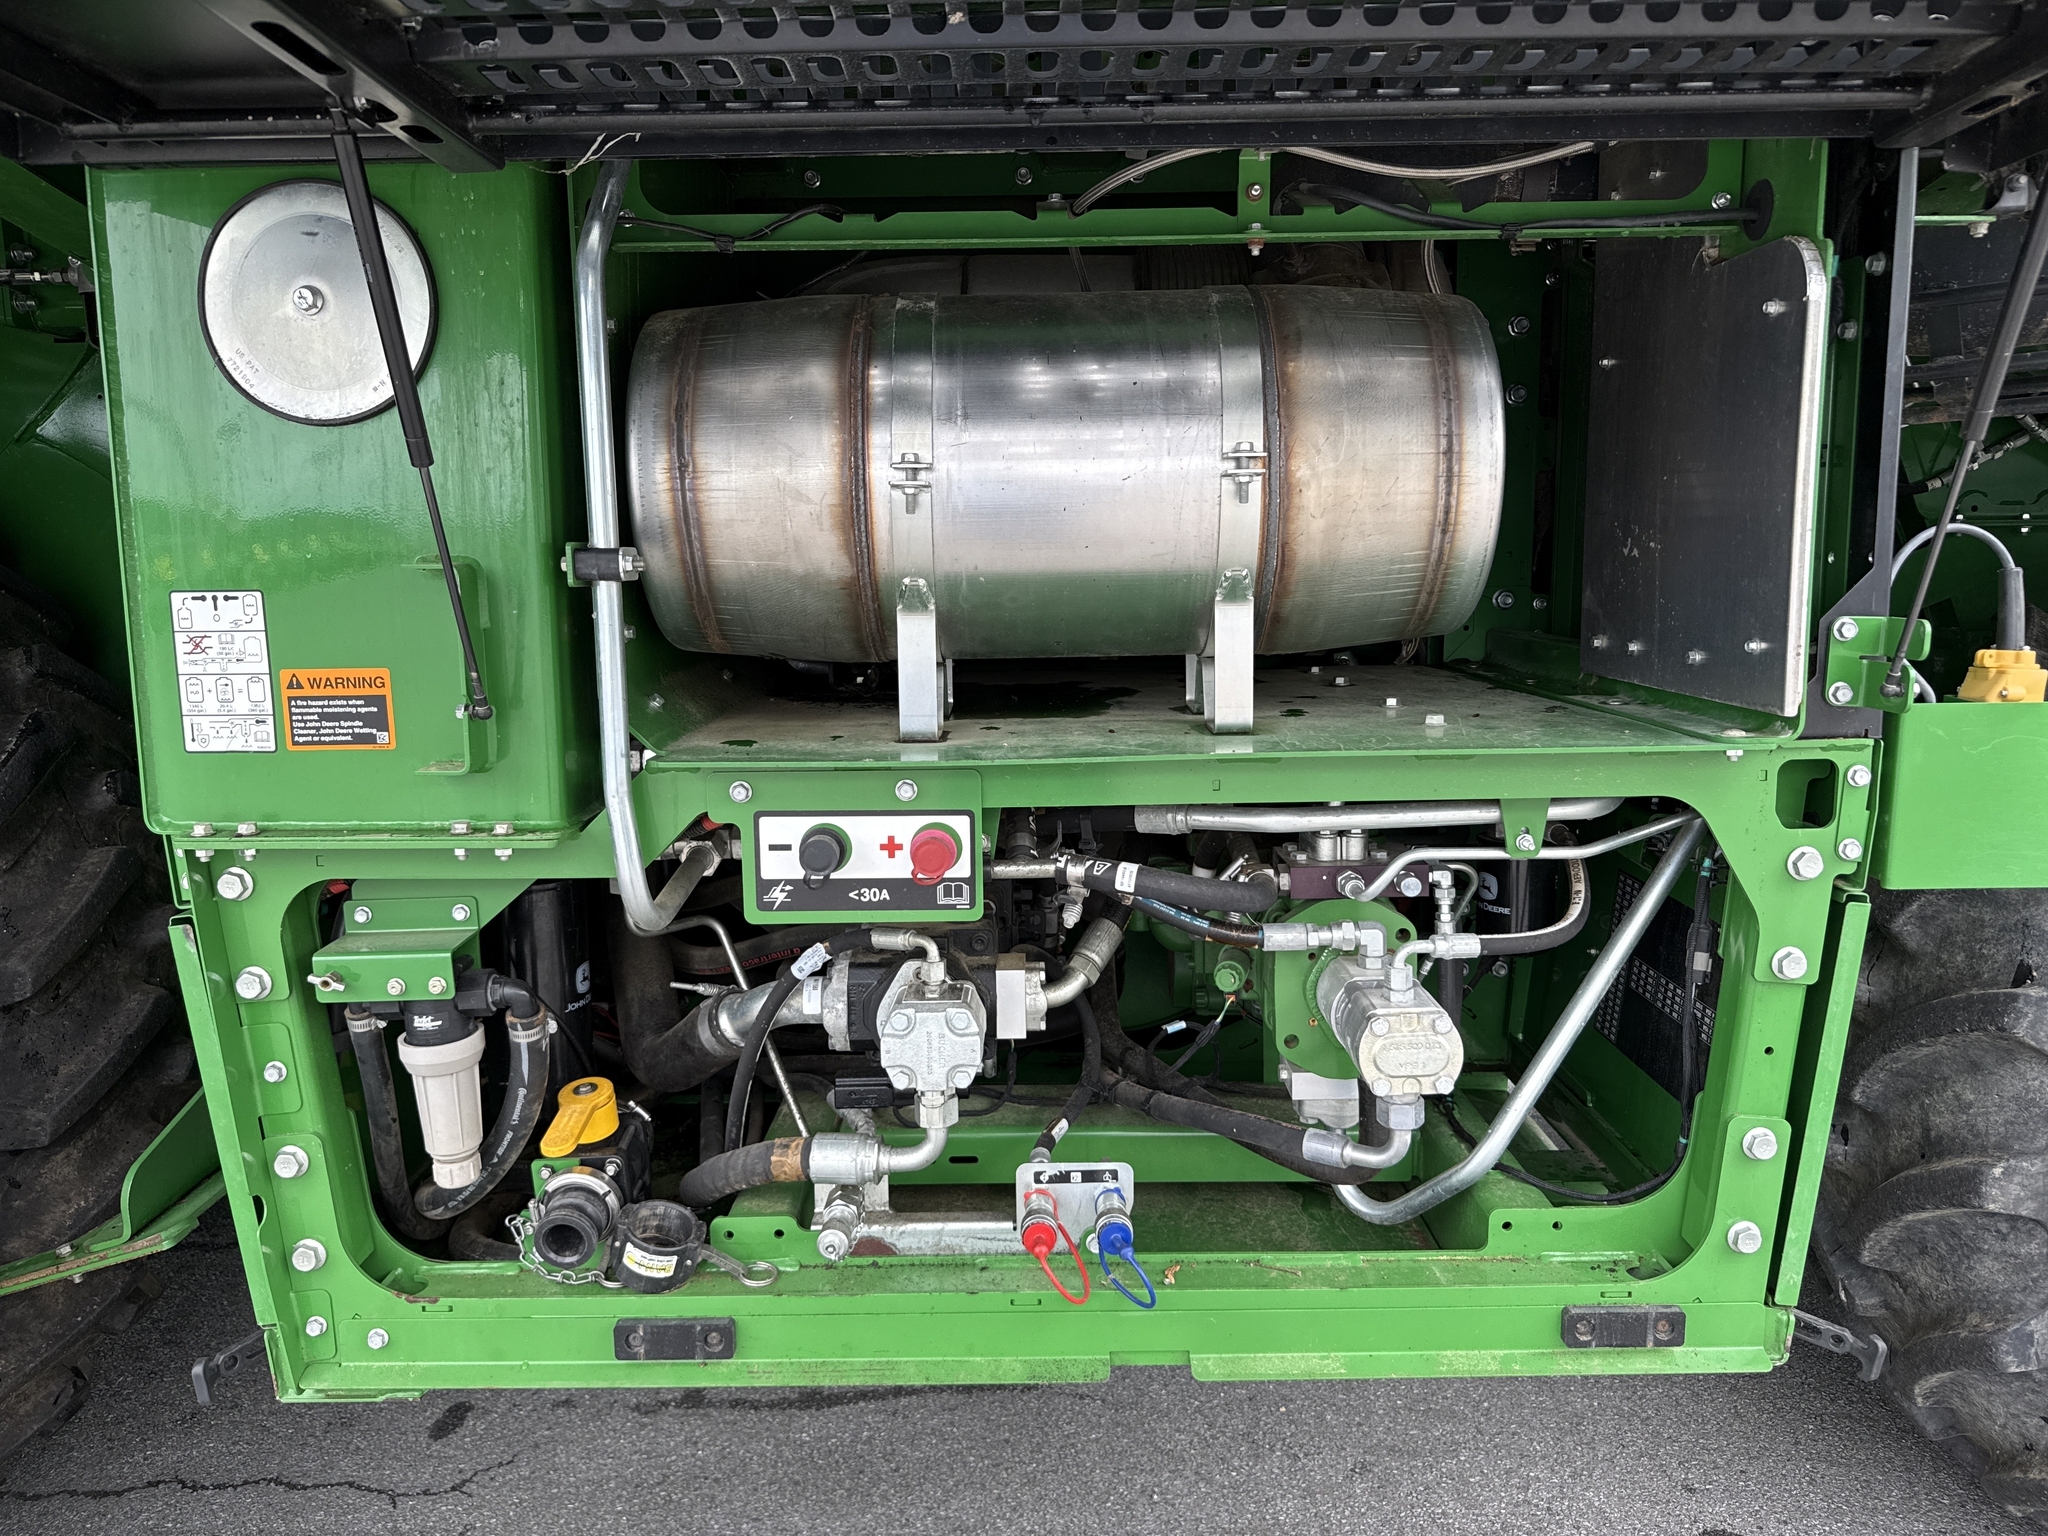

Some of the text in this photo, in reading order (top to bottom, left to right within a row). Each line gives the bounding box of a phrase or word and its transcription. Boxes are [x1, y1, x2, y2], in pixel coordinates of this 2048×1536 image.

[235, 347, 260, 374] US PAT
[307, 676, 386, 690] WARNING
[340, 720, 363, 728] Spindle
[353, 727, 377, 735] Wetting
[294, 735, 312, 743] Agent
[848, 887, 890, 902] <30A
[1484, 902, 1511, 915] DEERE
[564, 998, 586, 1013] JOHN
[496, 1130, 514, 1157] FRONTIER
